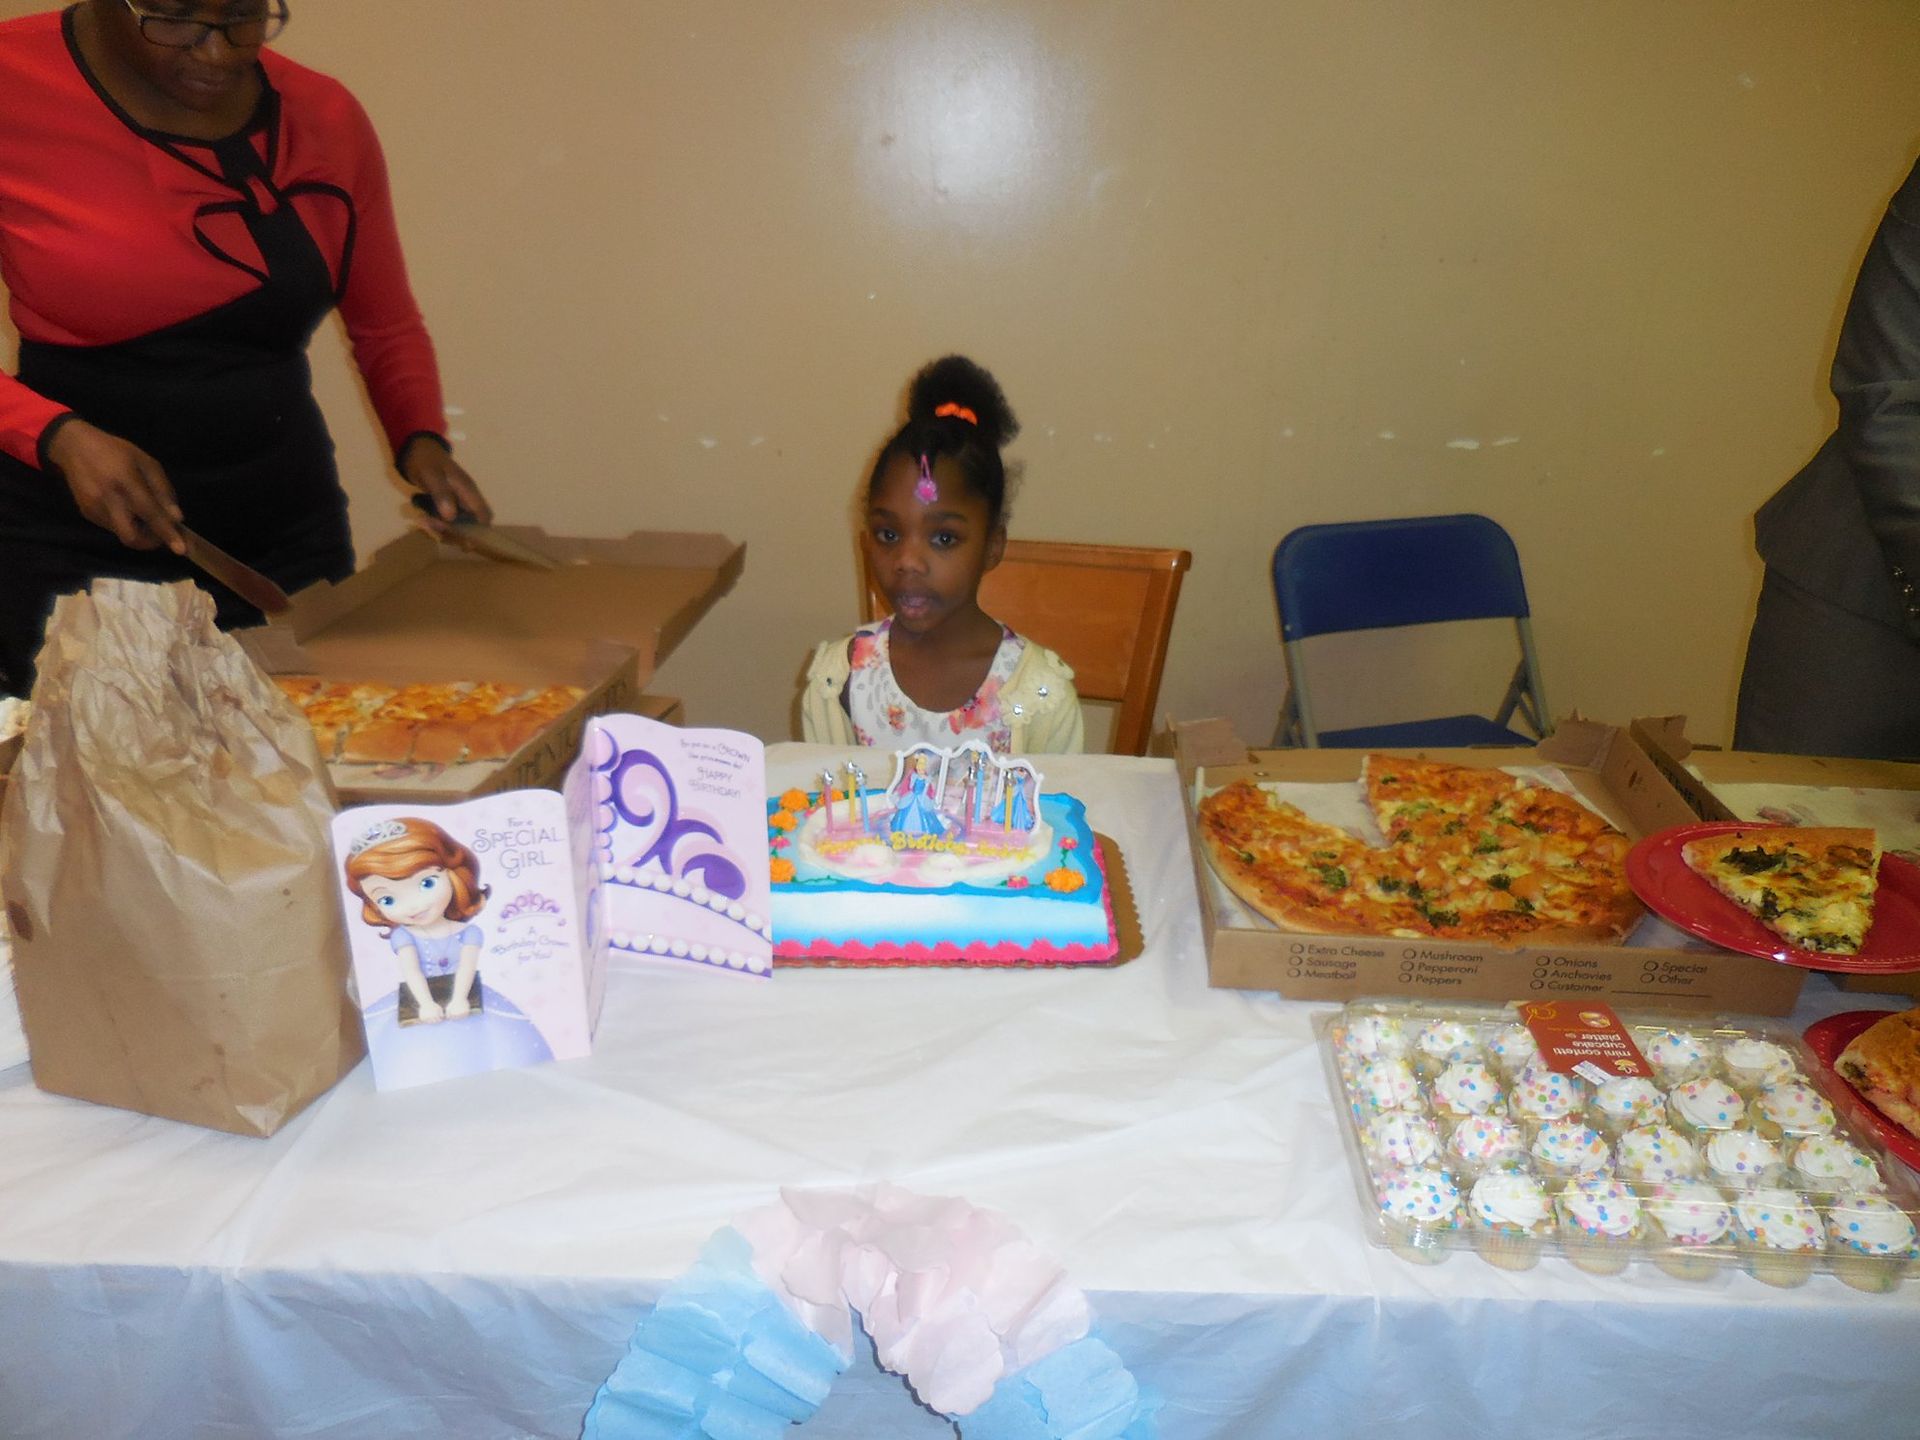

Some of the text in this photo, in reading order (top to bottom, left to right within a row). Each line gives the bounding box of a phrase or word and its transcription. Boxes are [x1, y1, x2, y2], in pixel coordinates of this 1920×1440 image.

[472, 827, 565, 853] SPECIAL
[499, 848, 553, 879] GIRL
[1307, 945, 1385, 958] Extra Cheese
[1419, 950, 1484, 963] Mushroom
[1306, 957, 1358, 969] Sausage
[1417, 962, 1480, 975] Pepperoni
[1553, 957, 1598, 969] Onions
[1660, 962, 1709, 975] Special
[1304, 969, 1358, 981] Meatball
[1415, 974, 1463, 987] Peppers
[1658, 974, 1696, 986] Other
[1547, 980, 1606, 993] Customer
[1581, 1032, 1622, 1042] platter
[1572, 1040, 1626, 1050] cupcake
[1552, 1047, 1632, 1058] mini confetti
